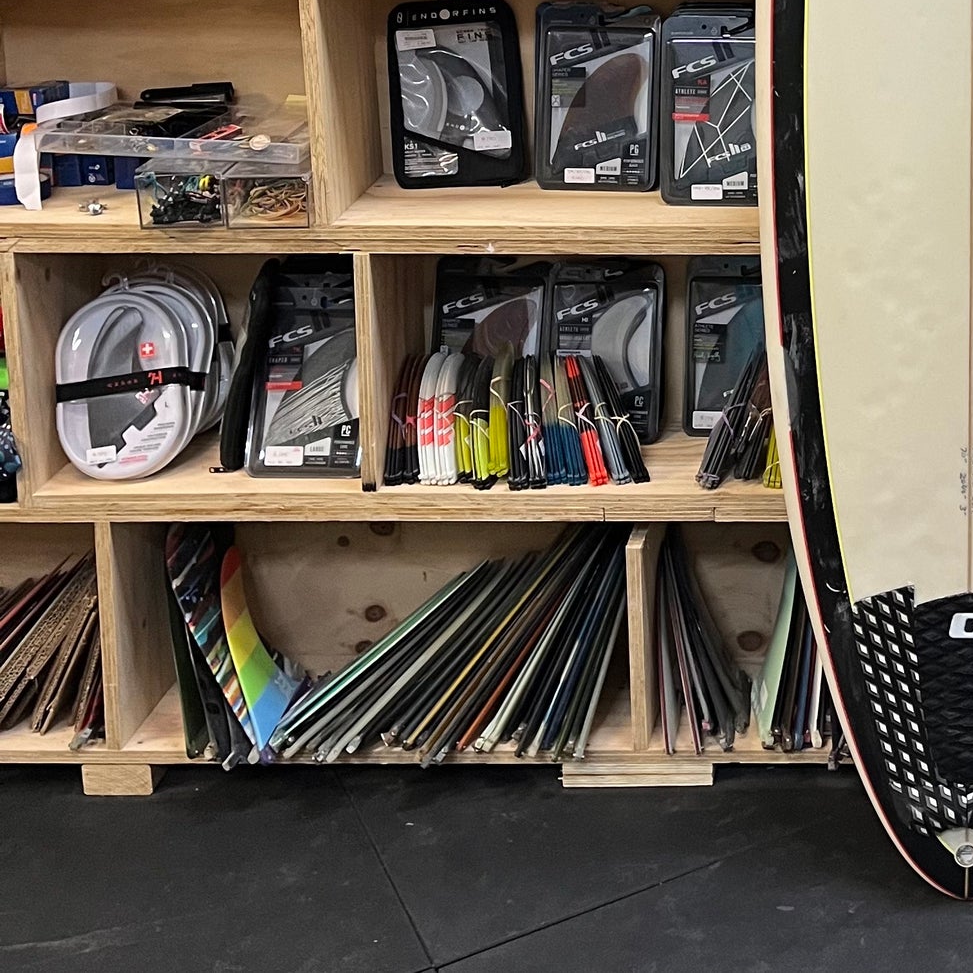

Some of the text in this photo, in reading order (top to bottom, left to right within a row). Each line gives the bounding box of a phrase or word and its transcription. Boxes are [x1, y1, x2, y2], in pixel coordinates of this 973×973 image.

[550, 43, 594, 66] FCS
[671, 55, 717, 79] FCS
[442, 292, 484, 315] FCS
[556, 298, 599, 321] FCS
[695, 292, 737, 315] FCS
[269, 325, 313, 348] FCS
[341, 425, 351, 435] PC
